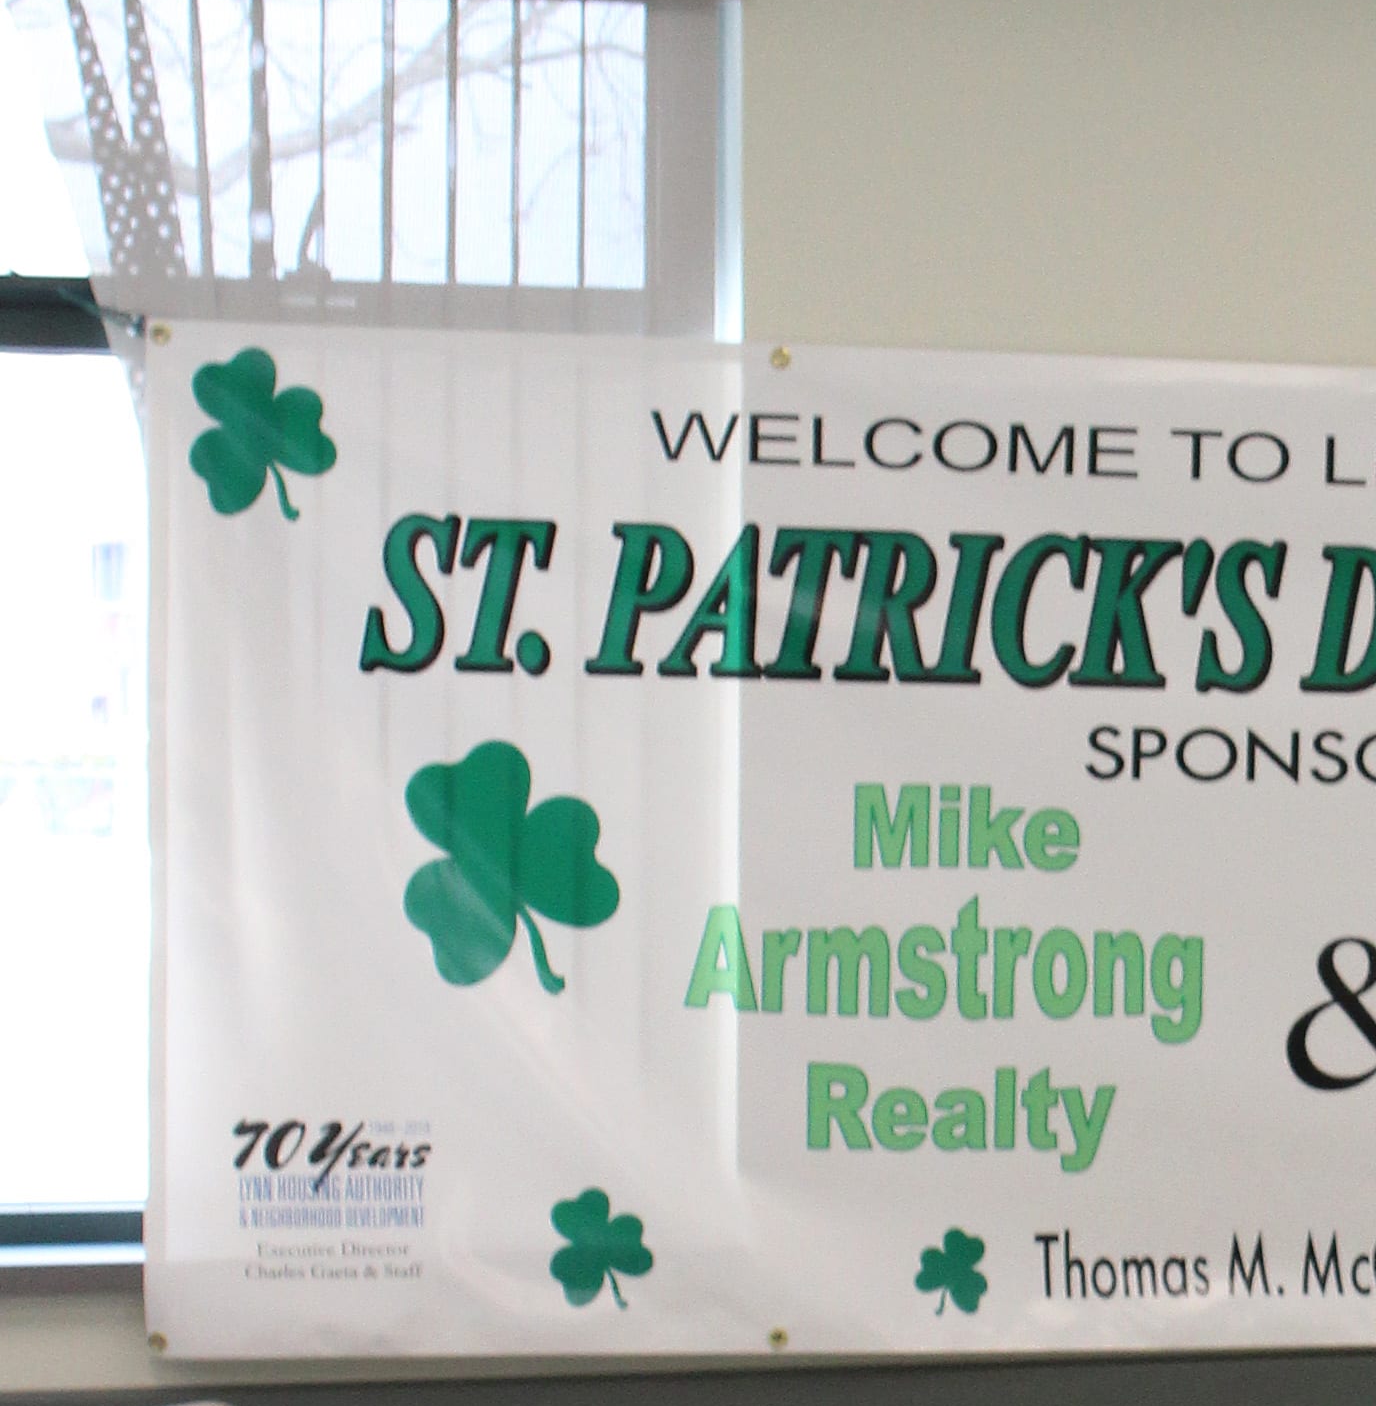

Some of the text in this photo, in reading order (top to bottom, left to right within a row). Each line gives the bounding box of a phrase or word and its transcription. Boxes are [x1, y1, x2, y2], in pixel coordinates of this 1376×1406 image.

[651, 410, 1139, 480] WELCOME
[1170, 428, 1291, 483] TO
[359, 512, 557, 677] ST.
[585, 521, 1287, 695] PATRICK'S
[852, 782, 1081, 872] Mike
[683, 895, 1204, 1045] Armstrong
[805, 1061, 1117, 1173] Realty
[233, 1119, 431, 1192] 70 Years
[239, 1174, 273, 1203] LYNN
[344, 1174, 424, 1203] AUTHORITY
[243, 1262, 306, 1280] Charles
[256, 1240, 410, 1258] Executive Director
[1034, 1227, 1210, 1299] Thomas
[1228, 1229, 1285, 1296] M.
